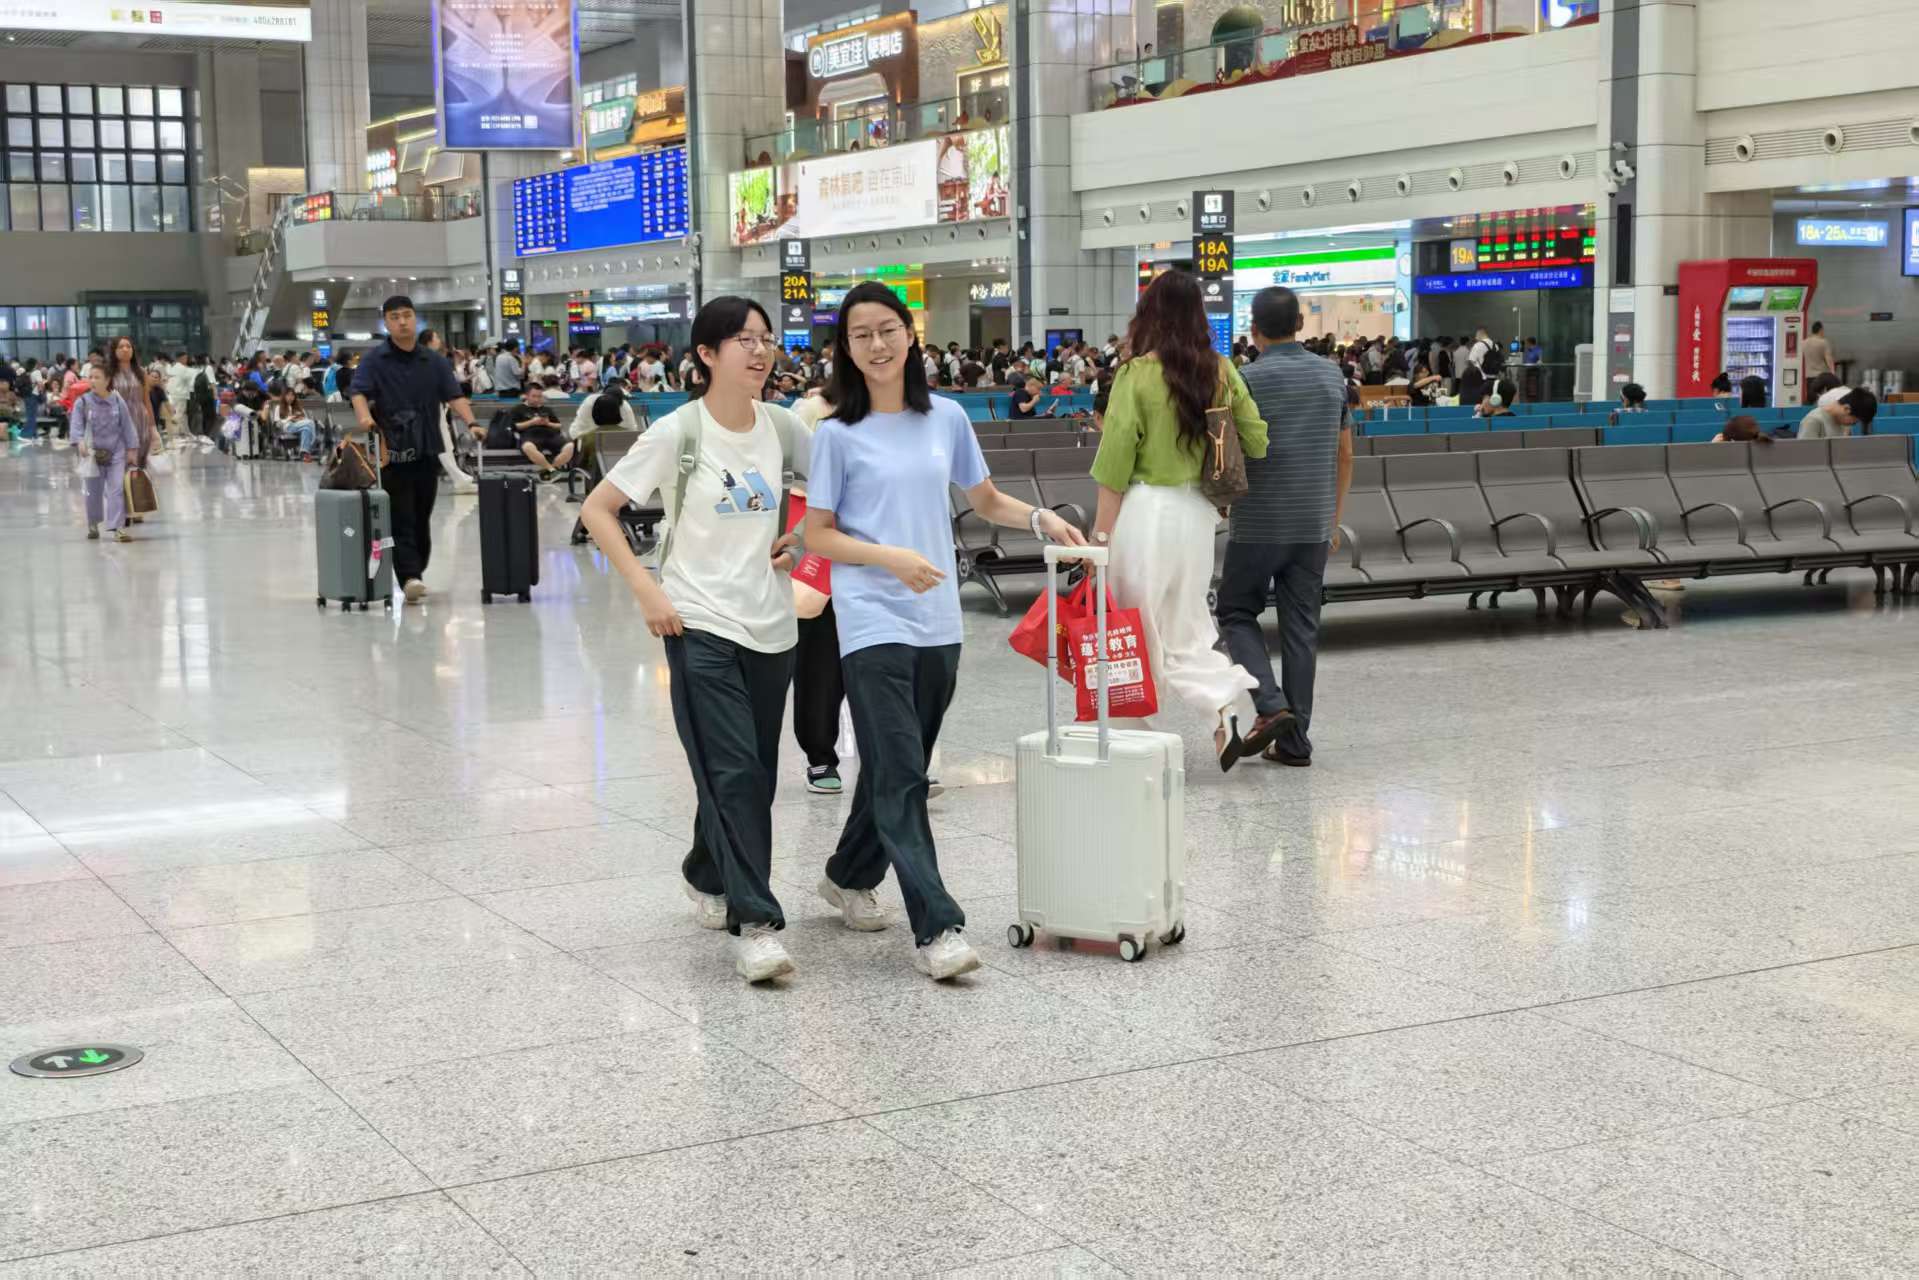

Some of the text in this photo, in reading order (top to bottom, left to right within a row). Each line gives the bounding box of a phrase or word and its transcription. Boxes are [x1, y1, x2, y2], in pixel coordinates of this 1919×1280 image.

[827, 38, 864, 71] 美宜佳
[1198, 241, 1229, 255] 18A
[1452, 247, 1474, 265] 19A
[1198, 258, 1229, 272] 19A
[784, 276, 807, 287] 20A
[784, 288, 807, 300] 21A
[503, 296, 522, 306] 22A
[503, 306, 522, 316] 23A
